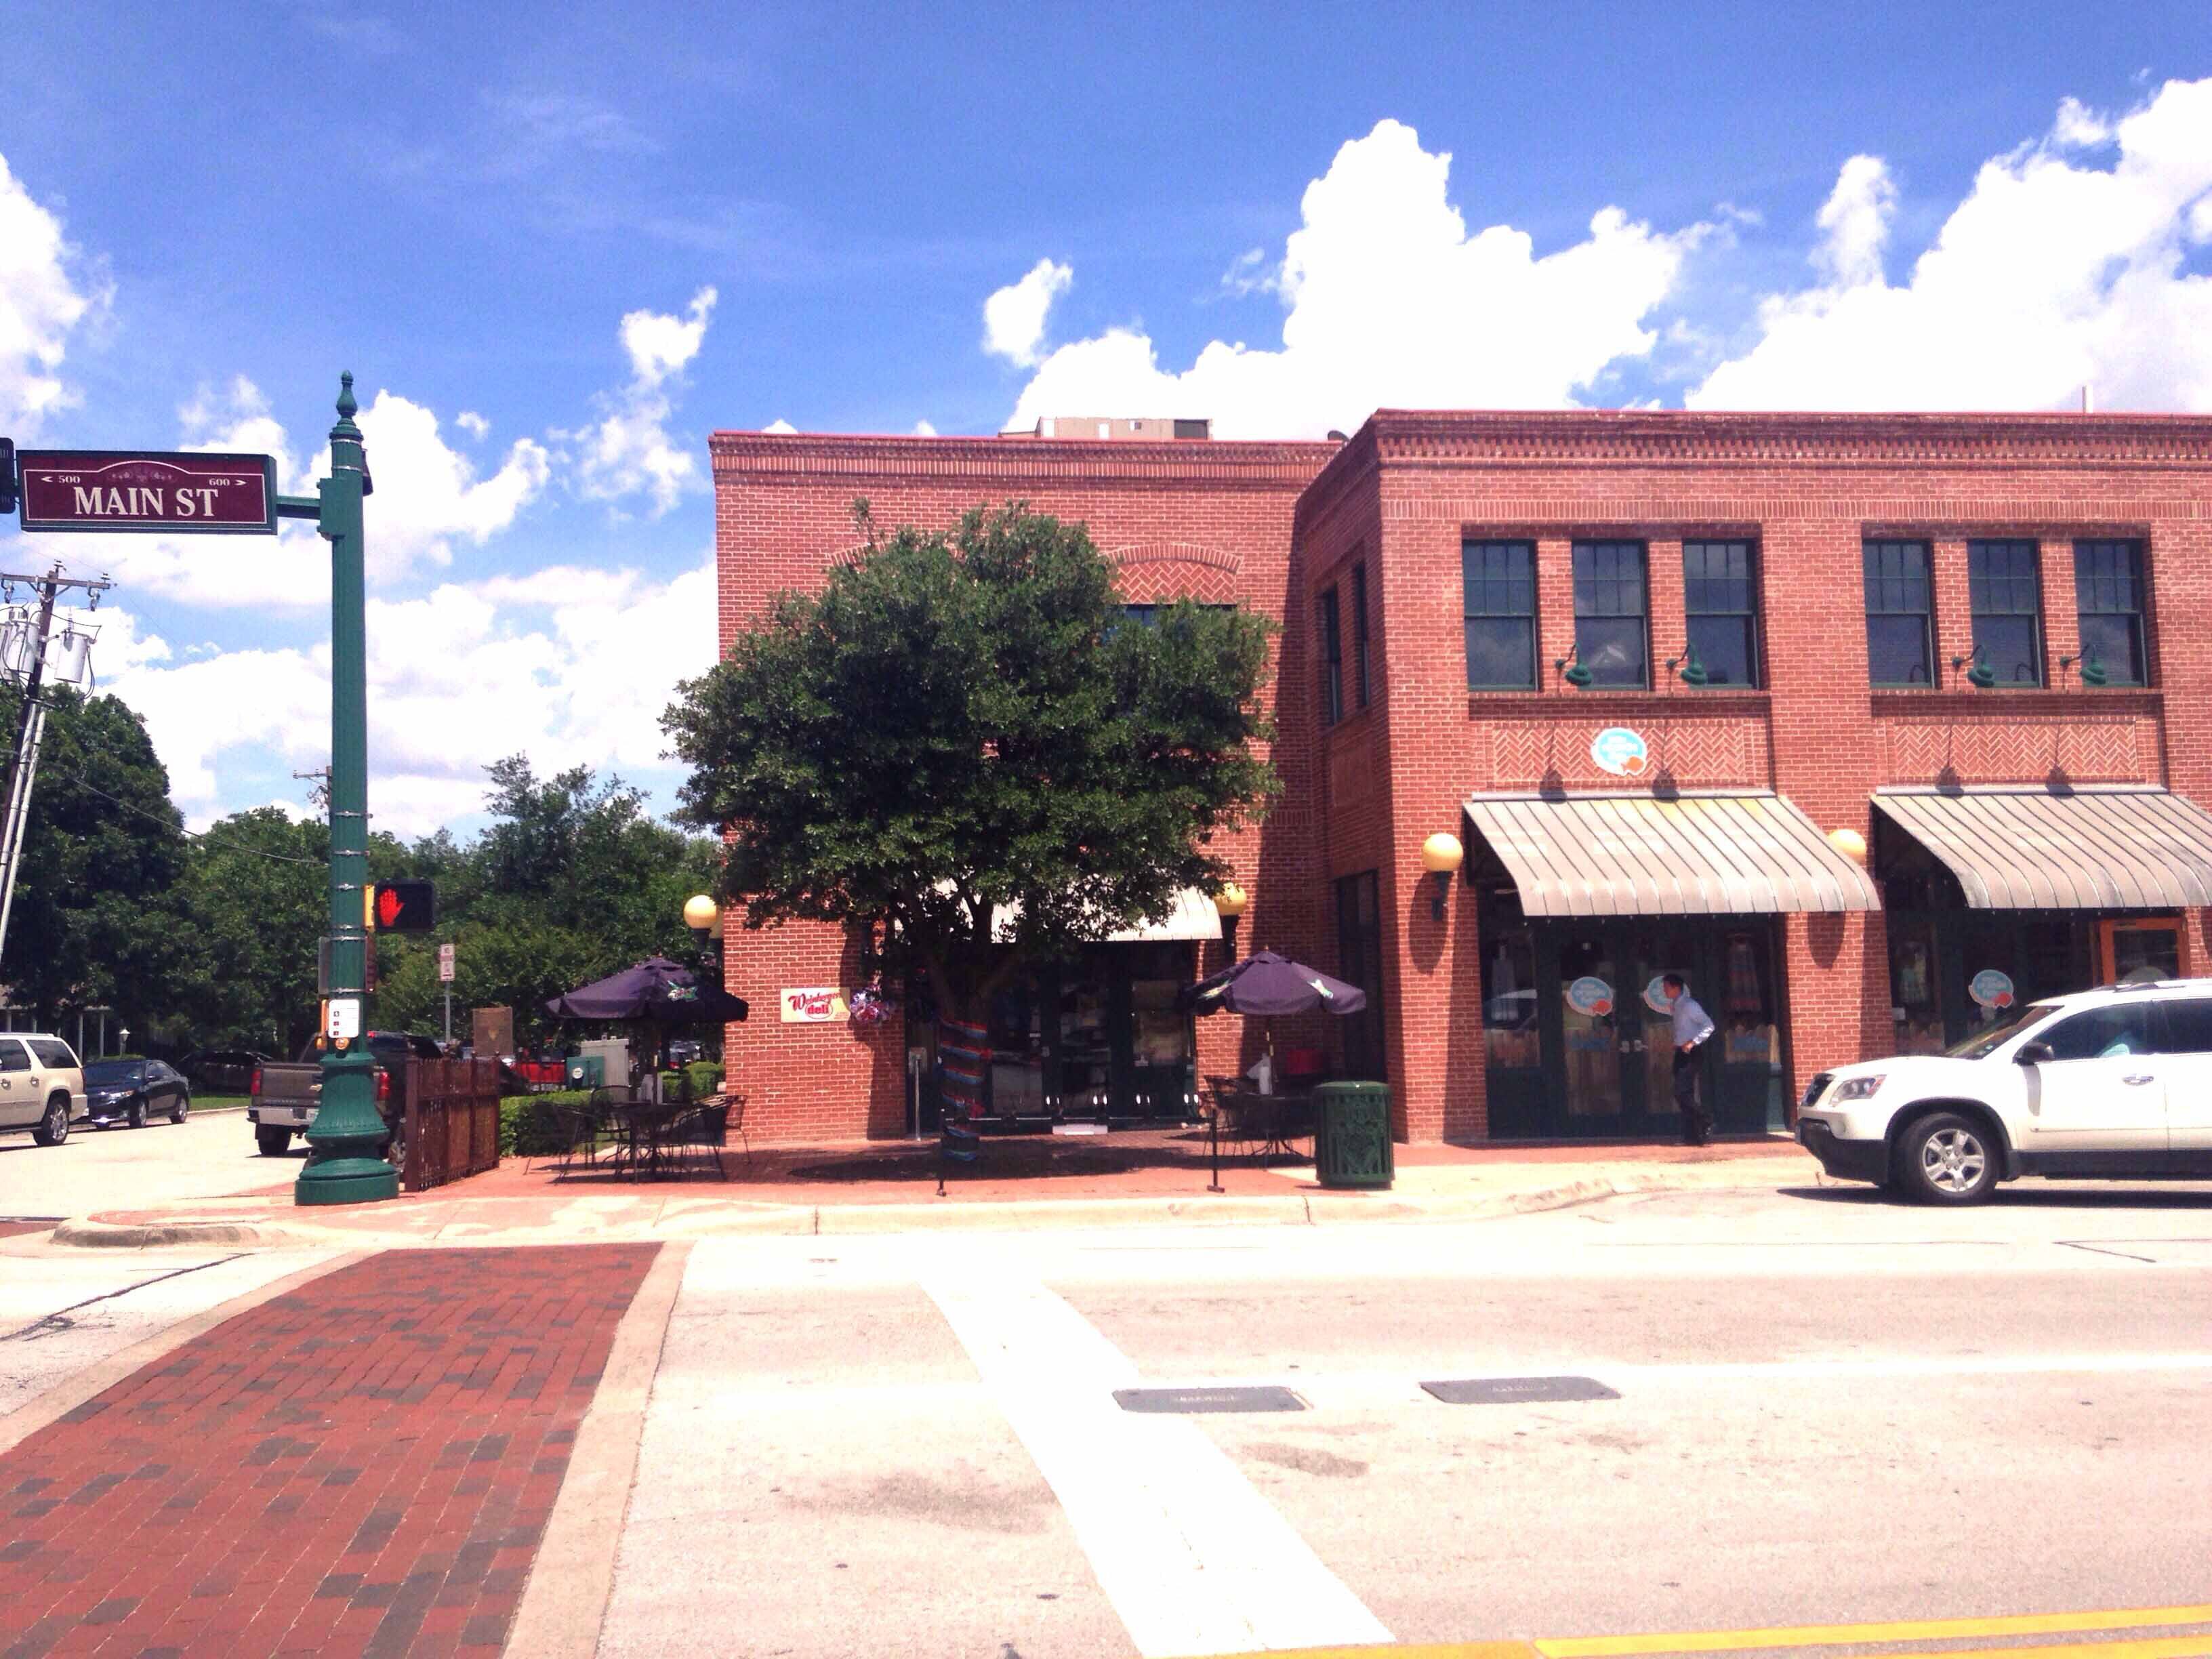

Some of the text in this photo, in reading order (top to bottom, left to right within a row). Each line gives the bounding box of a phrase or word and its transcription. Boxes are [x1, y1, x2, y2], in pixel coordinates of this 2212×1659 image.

[59, 475, 81, 483] 500
[209, 478, 230, 487] 600
[74, 487, 219, 517] MAIN ST
[807, 1004, 829, 1015] deli
